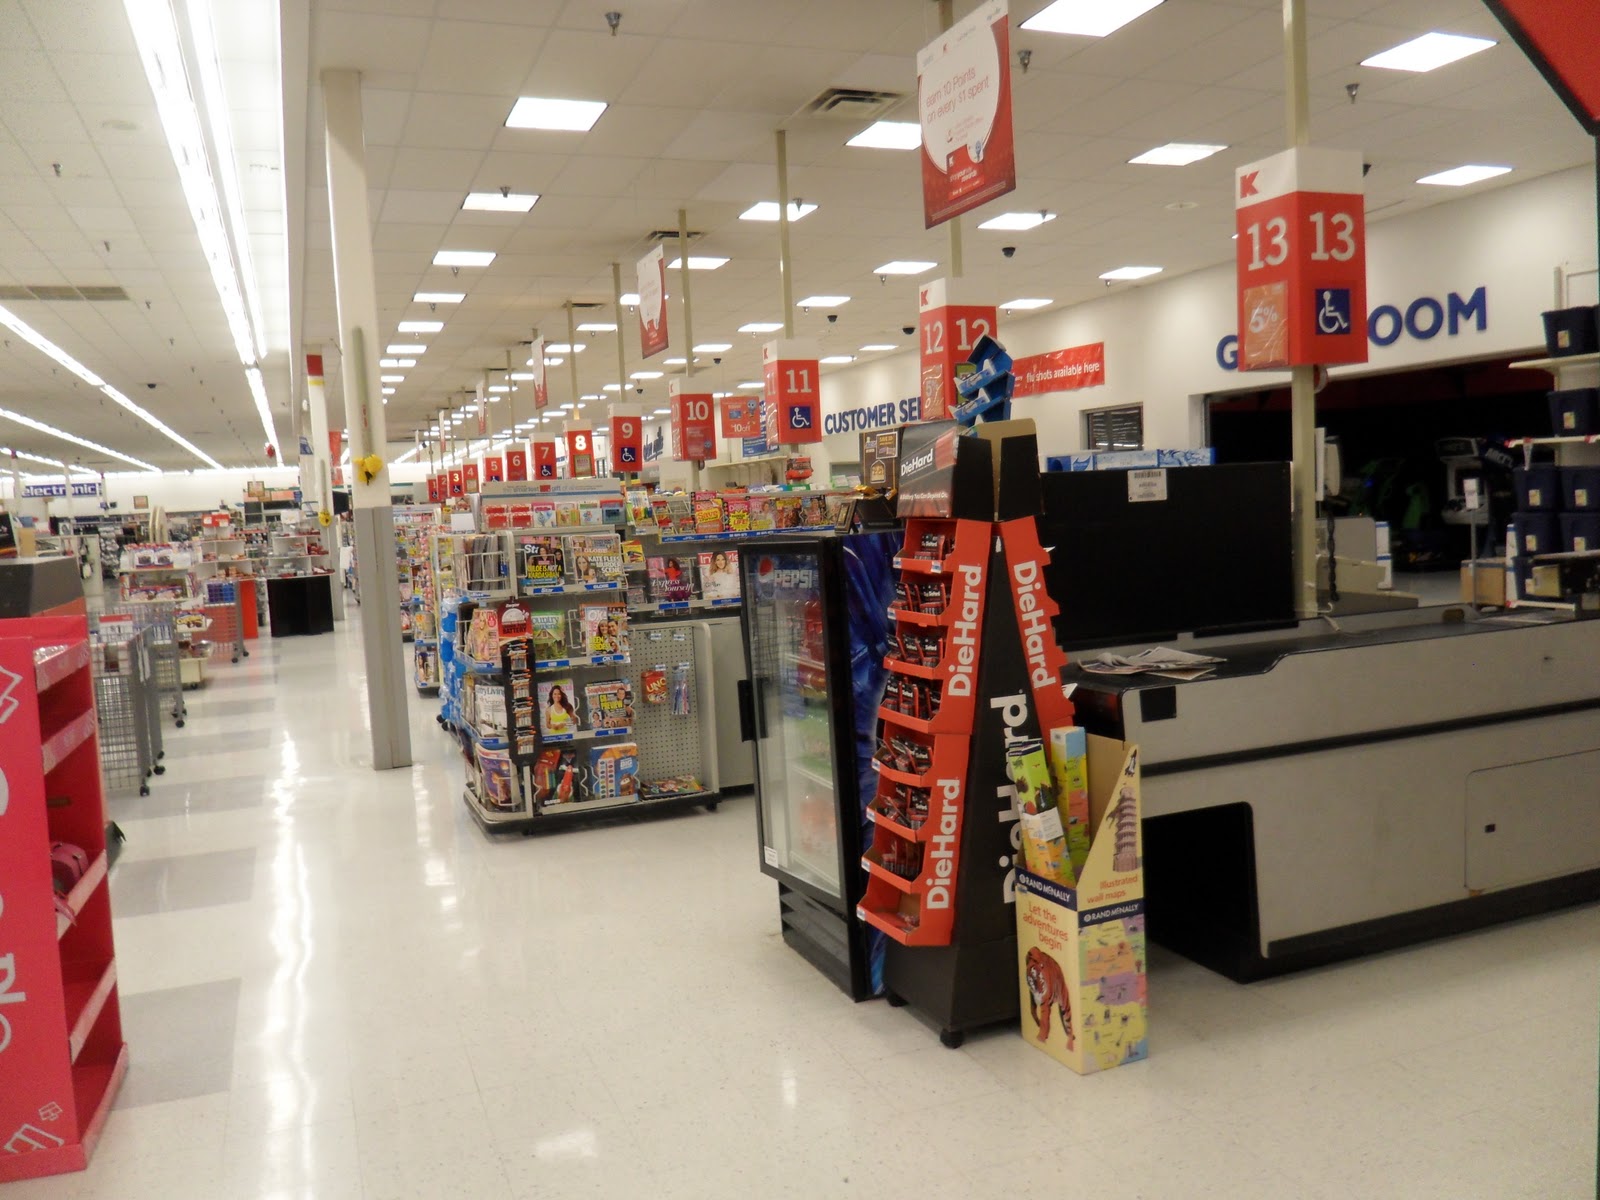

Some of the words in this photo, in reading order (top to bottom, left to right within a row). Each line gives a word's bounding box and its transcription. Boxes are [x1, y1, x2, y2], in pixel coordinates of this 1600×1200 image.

[953, 67, 976, 92] Points
[967, 75, 989, 101] spent
[1240, 171, 1259, 199] K
[1247, 217, 1289, 271] 13
[1309, 212, 1356, 262] 13
[1368, 287, 1487, 346] OOM
[924, 321, 944, 355] 12
[786, 369, 812, 394] 11
[1036, 369, 1052, 382] shots
[1054, 364, 1082, 379] available
[1083, 362, 1100, 374] here
[686, 401, 709, 421] 10
[825, 401, 897, 435] CUSTOMER
[621, 422, 633, 439] 9
[540, 446, 550, 459] 7
[574, 435, 587, 451] 8
[467, 467, 474, 476] 4
[490, 461, 498, 471] 5
[513, 455, 521, 467] 6
[901, 448, 934, 476] DieHard
[453, 473, 460, 482] 3
[21, 481, 103, 498] electrnic
[774, 569, 812, 589] PEPSI
[948, 565, 982, 696] DieHard
[1014, 560, 1056, 689] DieHard
[646, 677, 667, 692] UNO
[927, 779, 961, 909] DieHard
[1025, 876, 1042, 892] RAND
[1087, 892, 1103, 904] wall
[1103, 889, 1126, 903] maps
[1029, 901, 1041, 915] Let
[1042, 908, 1057, 923] the
[1091, 909, 1111, 922] RAND
[1023, 911, 1069, 941] adventures
[1038, 929, 1062, 951] begin
